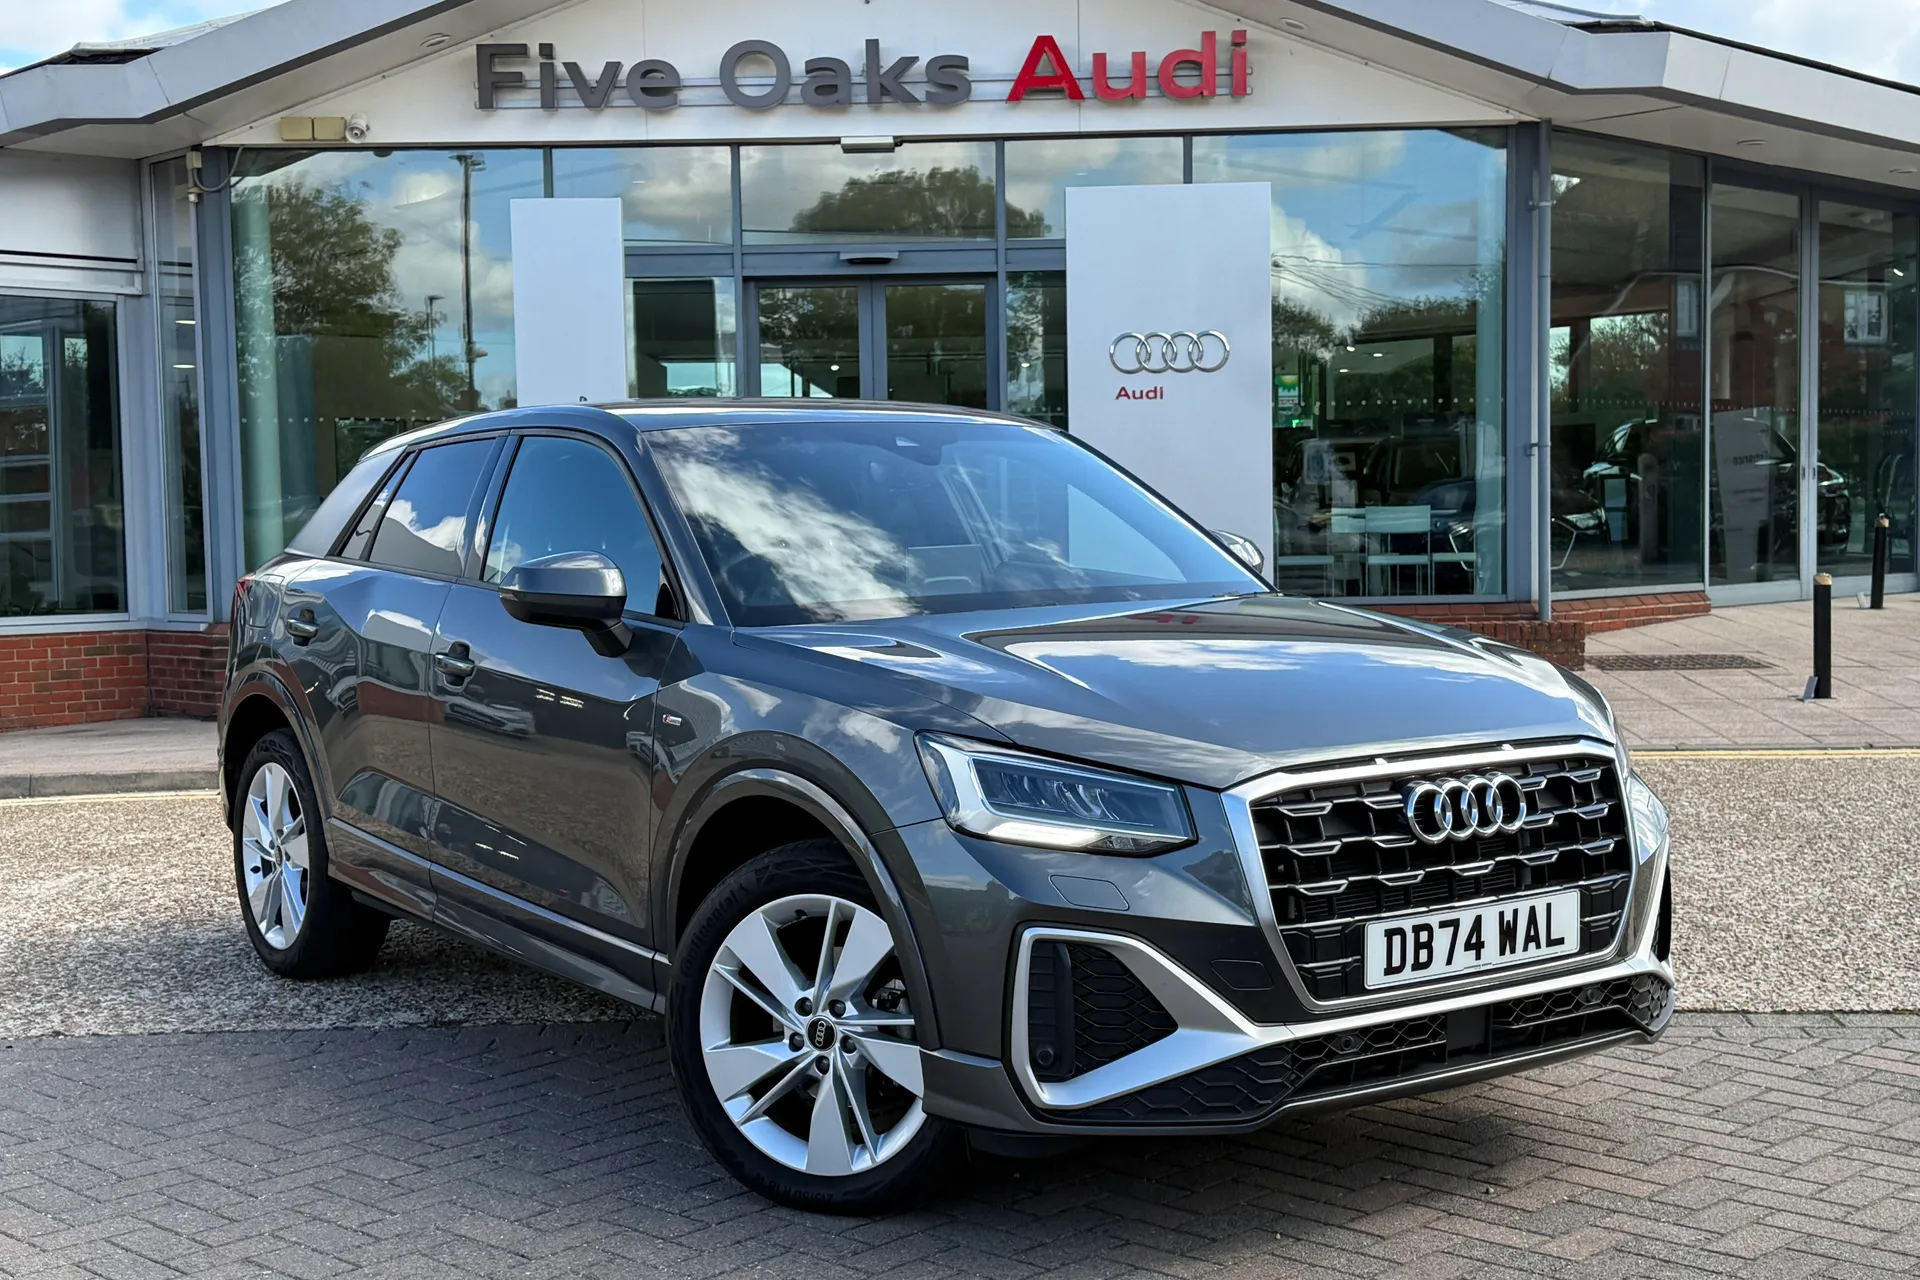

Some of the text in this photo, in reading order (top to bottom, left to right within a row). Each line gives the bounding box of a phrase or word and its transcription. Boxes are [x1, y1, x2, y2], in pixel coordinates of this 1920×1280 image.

[476, 30, 1247, 110] Five Oaks Audi
[1115, 386, 1164, 400] Audi
[1383, 902, 1565, 976] DB74 WAL
